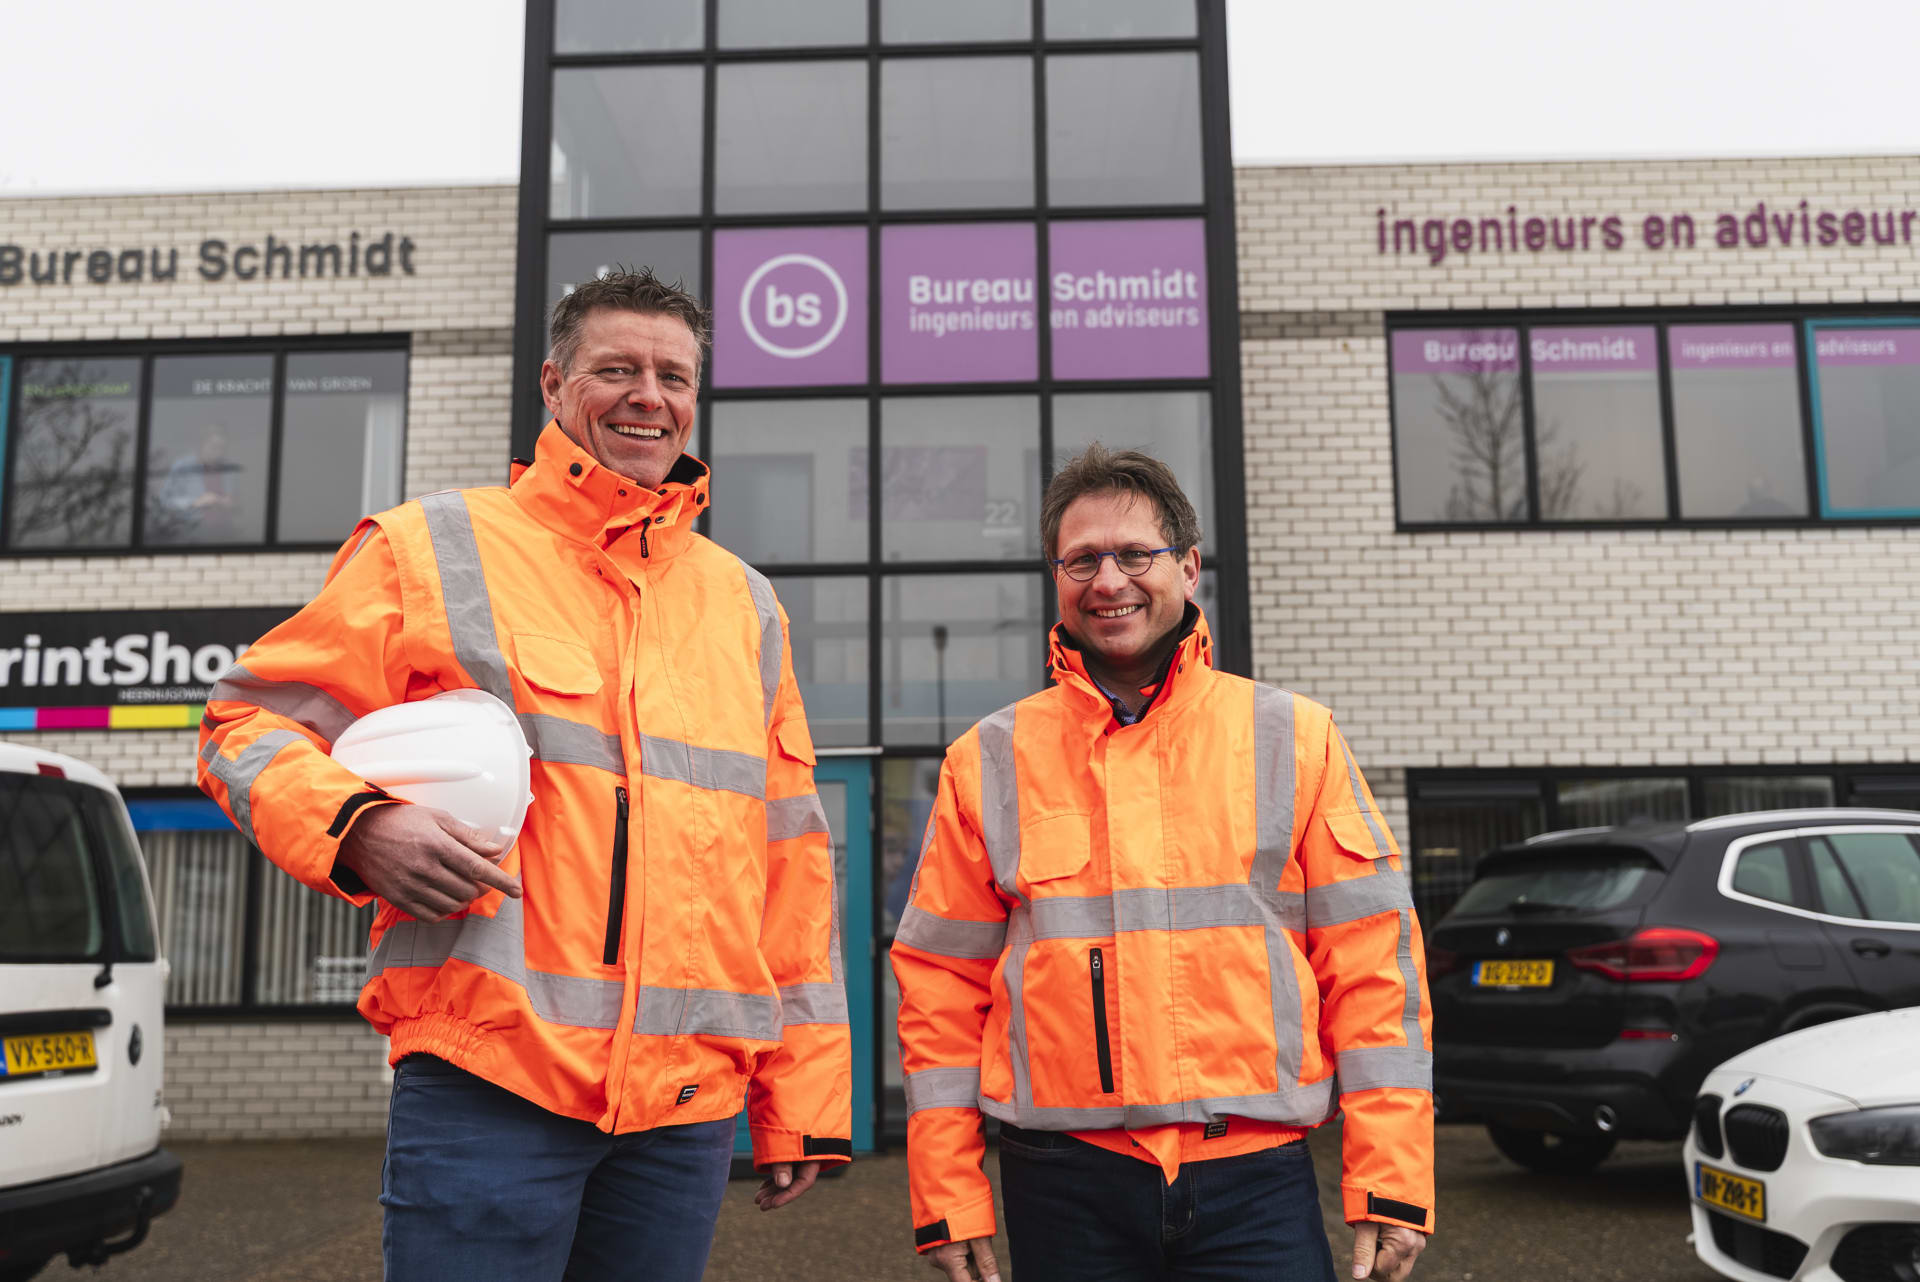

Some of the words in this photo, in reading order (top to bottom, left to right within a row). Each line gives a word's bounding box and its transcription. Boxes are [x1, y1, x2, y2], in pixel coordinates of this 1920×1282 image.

[1377, 205, 1624, 267] ingenieurs
[1643, 212, 1696, 250] en
[0, 245, 178, 285] Bureau
[198, 231, 416, 282] Schmidt
[909, 275, 1033, 304] Bureau
[1053, 268, 1199, 302] Schmidt
[766, 285, 822, 328] bs
[909, 306, 1035, 338] ingenieurs
[1050, 308, 1080, 329] en
[1084, 302, 1200, 329] adviseurs
[1423, 339, 1516, 363] Bureau
[1531, 337, 1637, 361] Schmidt
[1681, 341, 1767, 362] ingenieurs
[1771, 342, 1793, 356] en
[1816, 337, 1896, 356] adviseurs
[193, 380, 213, 394] DE
[215, 377, 272, 393] KRACHT
[320, 376, 373, 392] GROEN
[984, 501, 1017, 525] 22
[0, 630, 251, 687] rintSho
[9, 1035, 92, 1068] VX-560-R
